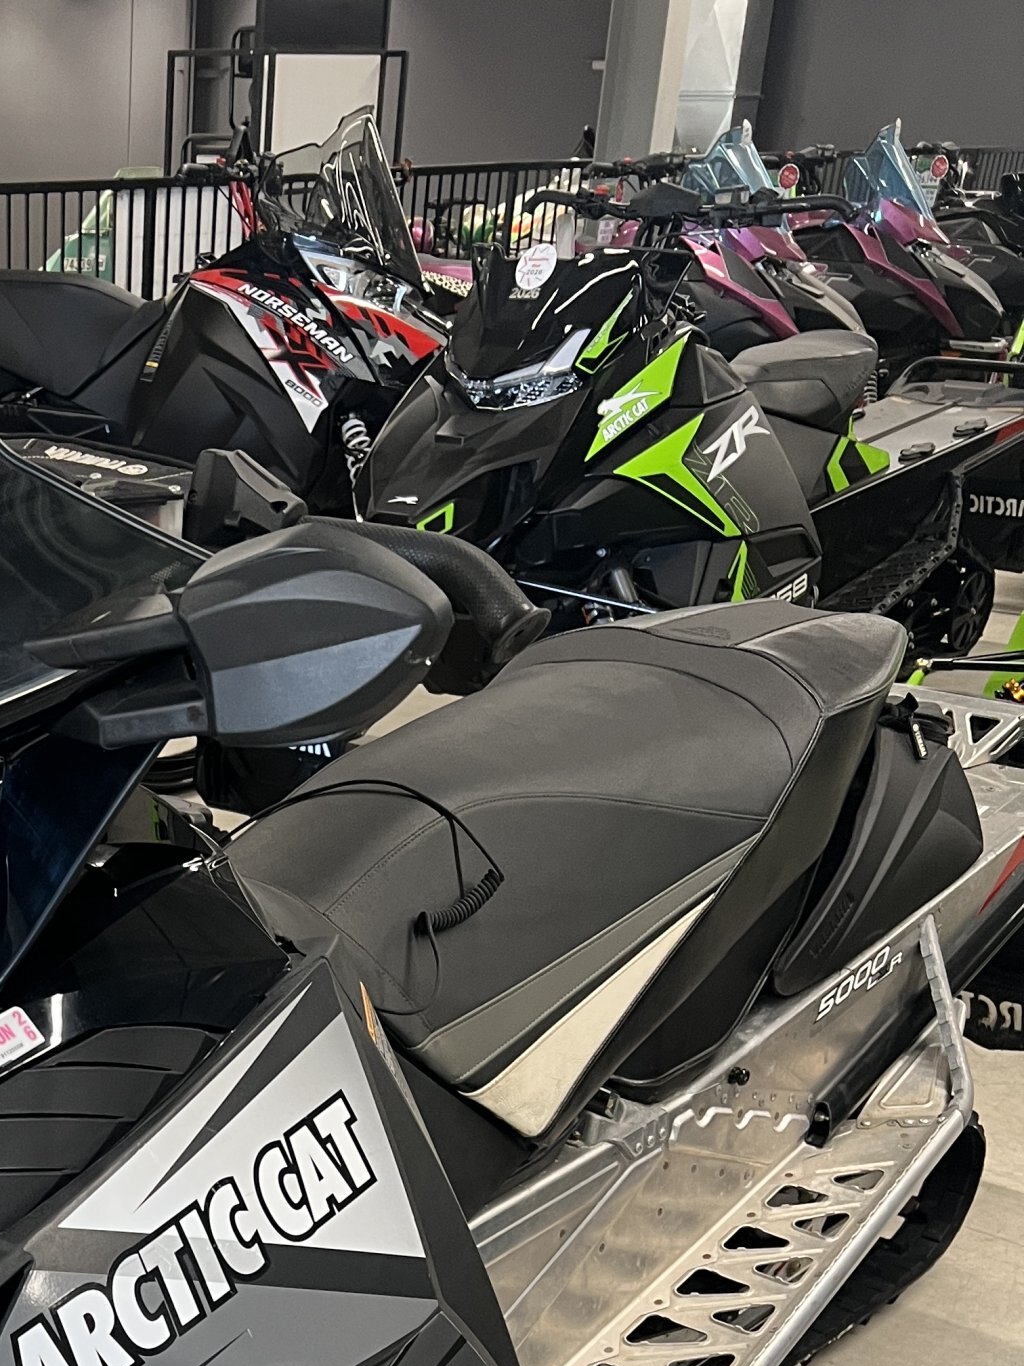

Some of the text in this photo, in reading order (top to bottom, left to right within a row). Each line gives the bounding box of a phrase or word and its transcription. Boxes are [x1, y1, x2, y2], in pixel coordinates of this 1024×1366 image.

[237, 283, 354, 364] NORSEMAN
[509, 287, 541, 299] 2026
[284, 379, 323, 408] 8000
[601, 397, 649, 443] ARCTIC CAT
[703, 405, 771, 483] ZR
[770, 573, 808, 602] 58
[815, 945, 891, 1021] 5000
[253, 1092, 377, 1242] CAT
